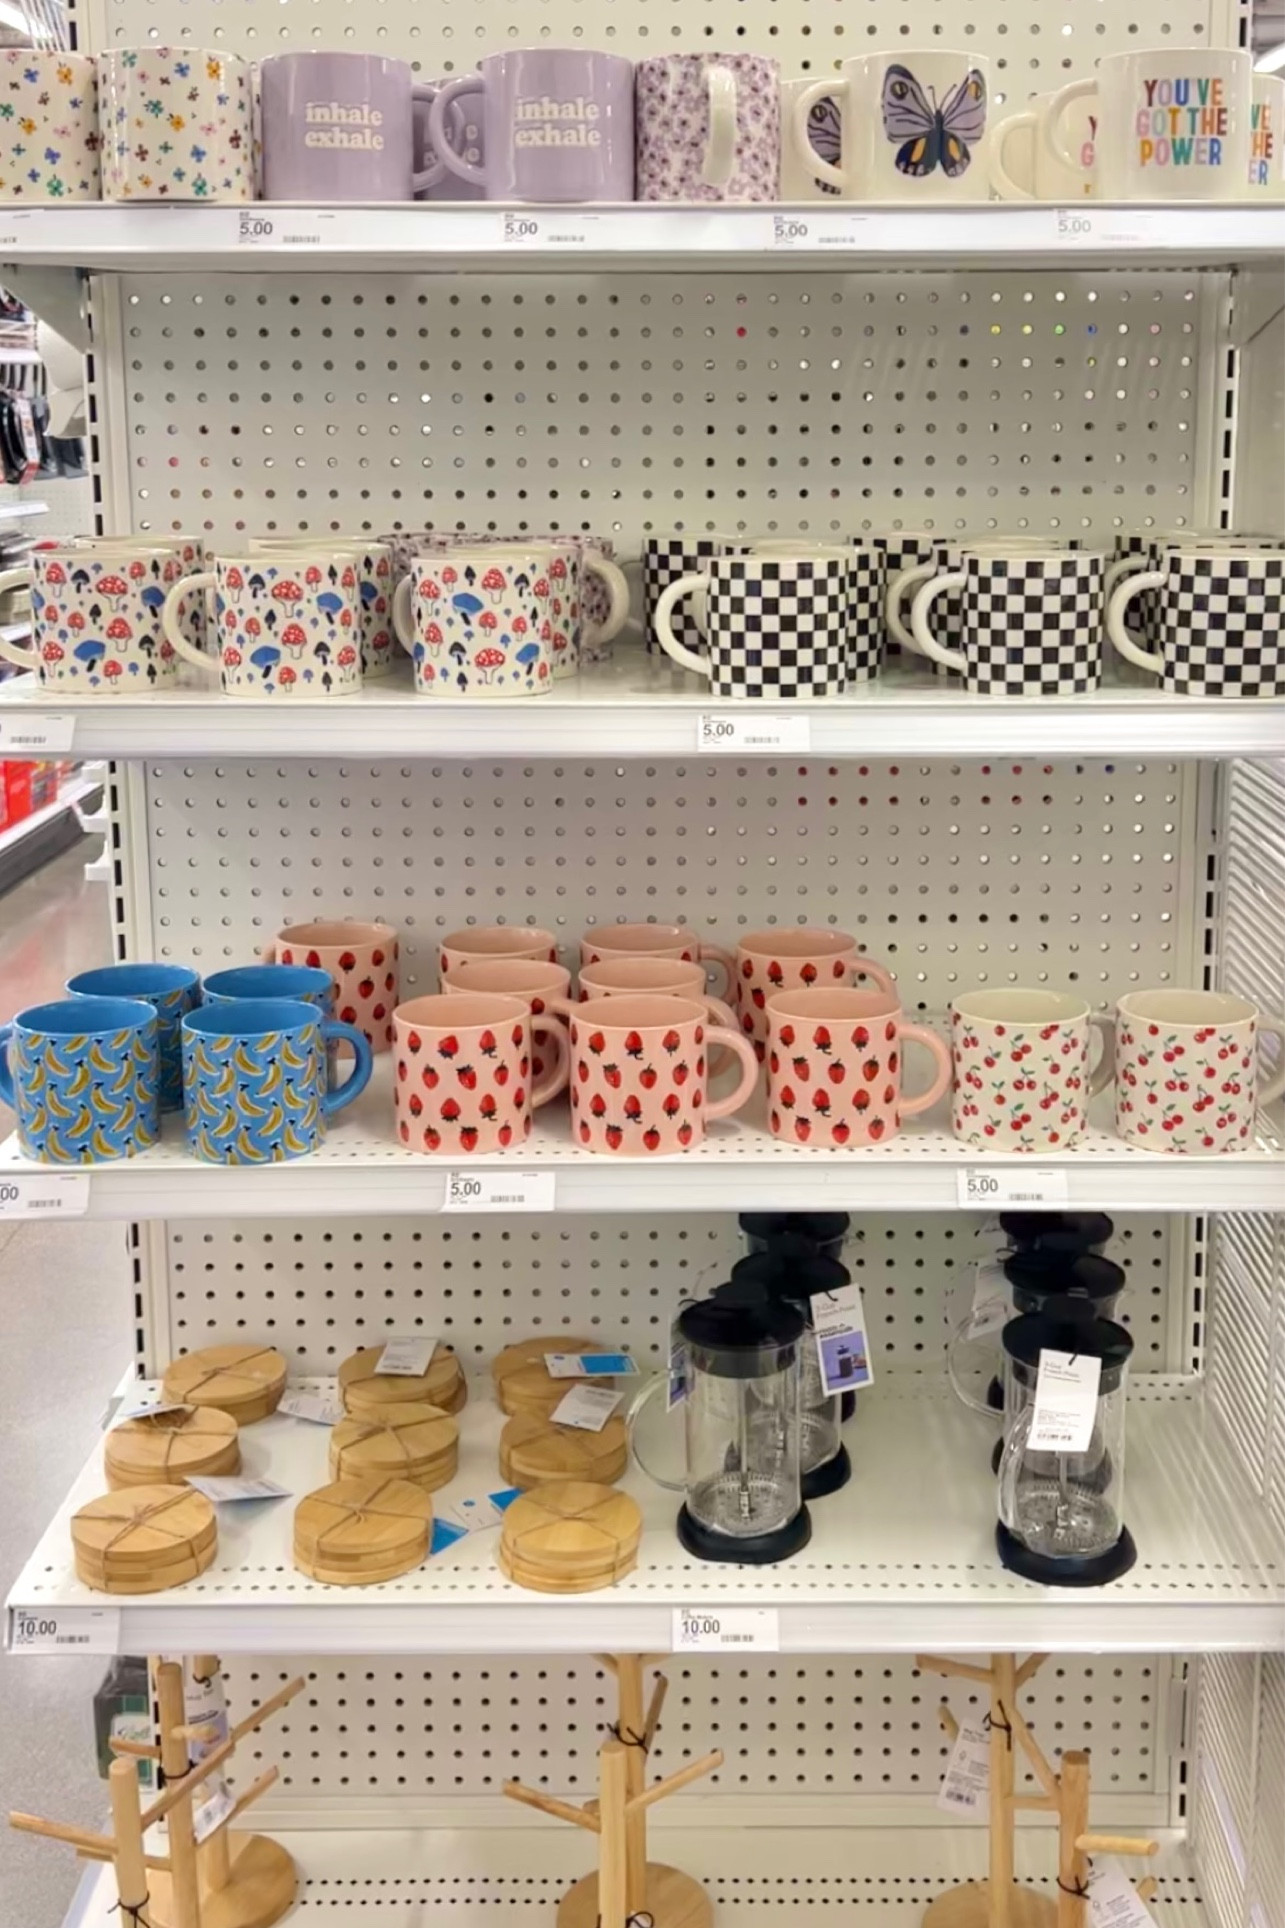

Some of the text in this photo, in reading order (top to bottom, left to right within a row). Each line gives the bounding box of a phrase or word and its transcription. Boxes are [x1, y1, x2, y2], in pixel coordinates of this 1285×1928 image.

[305, 102, 383, 126] inhale
[515, 97, 600, 121] inhale
[1136, 109, 1182, 137] GOT
[1186, 107, 1228, 137] THE
[305, 127, 384, 150] exhale
[514, 124, 601, 147] exhale
[1140, 137, 1222, 167] POWER
[239, 222, 273, 236] 5.00
[504, 222, 538, 236] 5.00
[774, 223, 808, 238] 5.00
[1057, 219, 1092, 233] 5.00
[702, 723, 735, 737] 5.00
[450, 1181, 482, 1196] 5.00
[967, 1178, 999, 1193] 5.00
[19, 1620, 57, 1635] 10.00
[682, 1619, 720, 1634] 10.00
